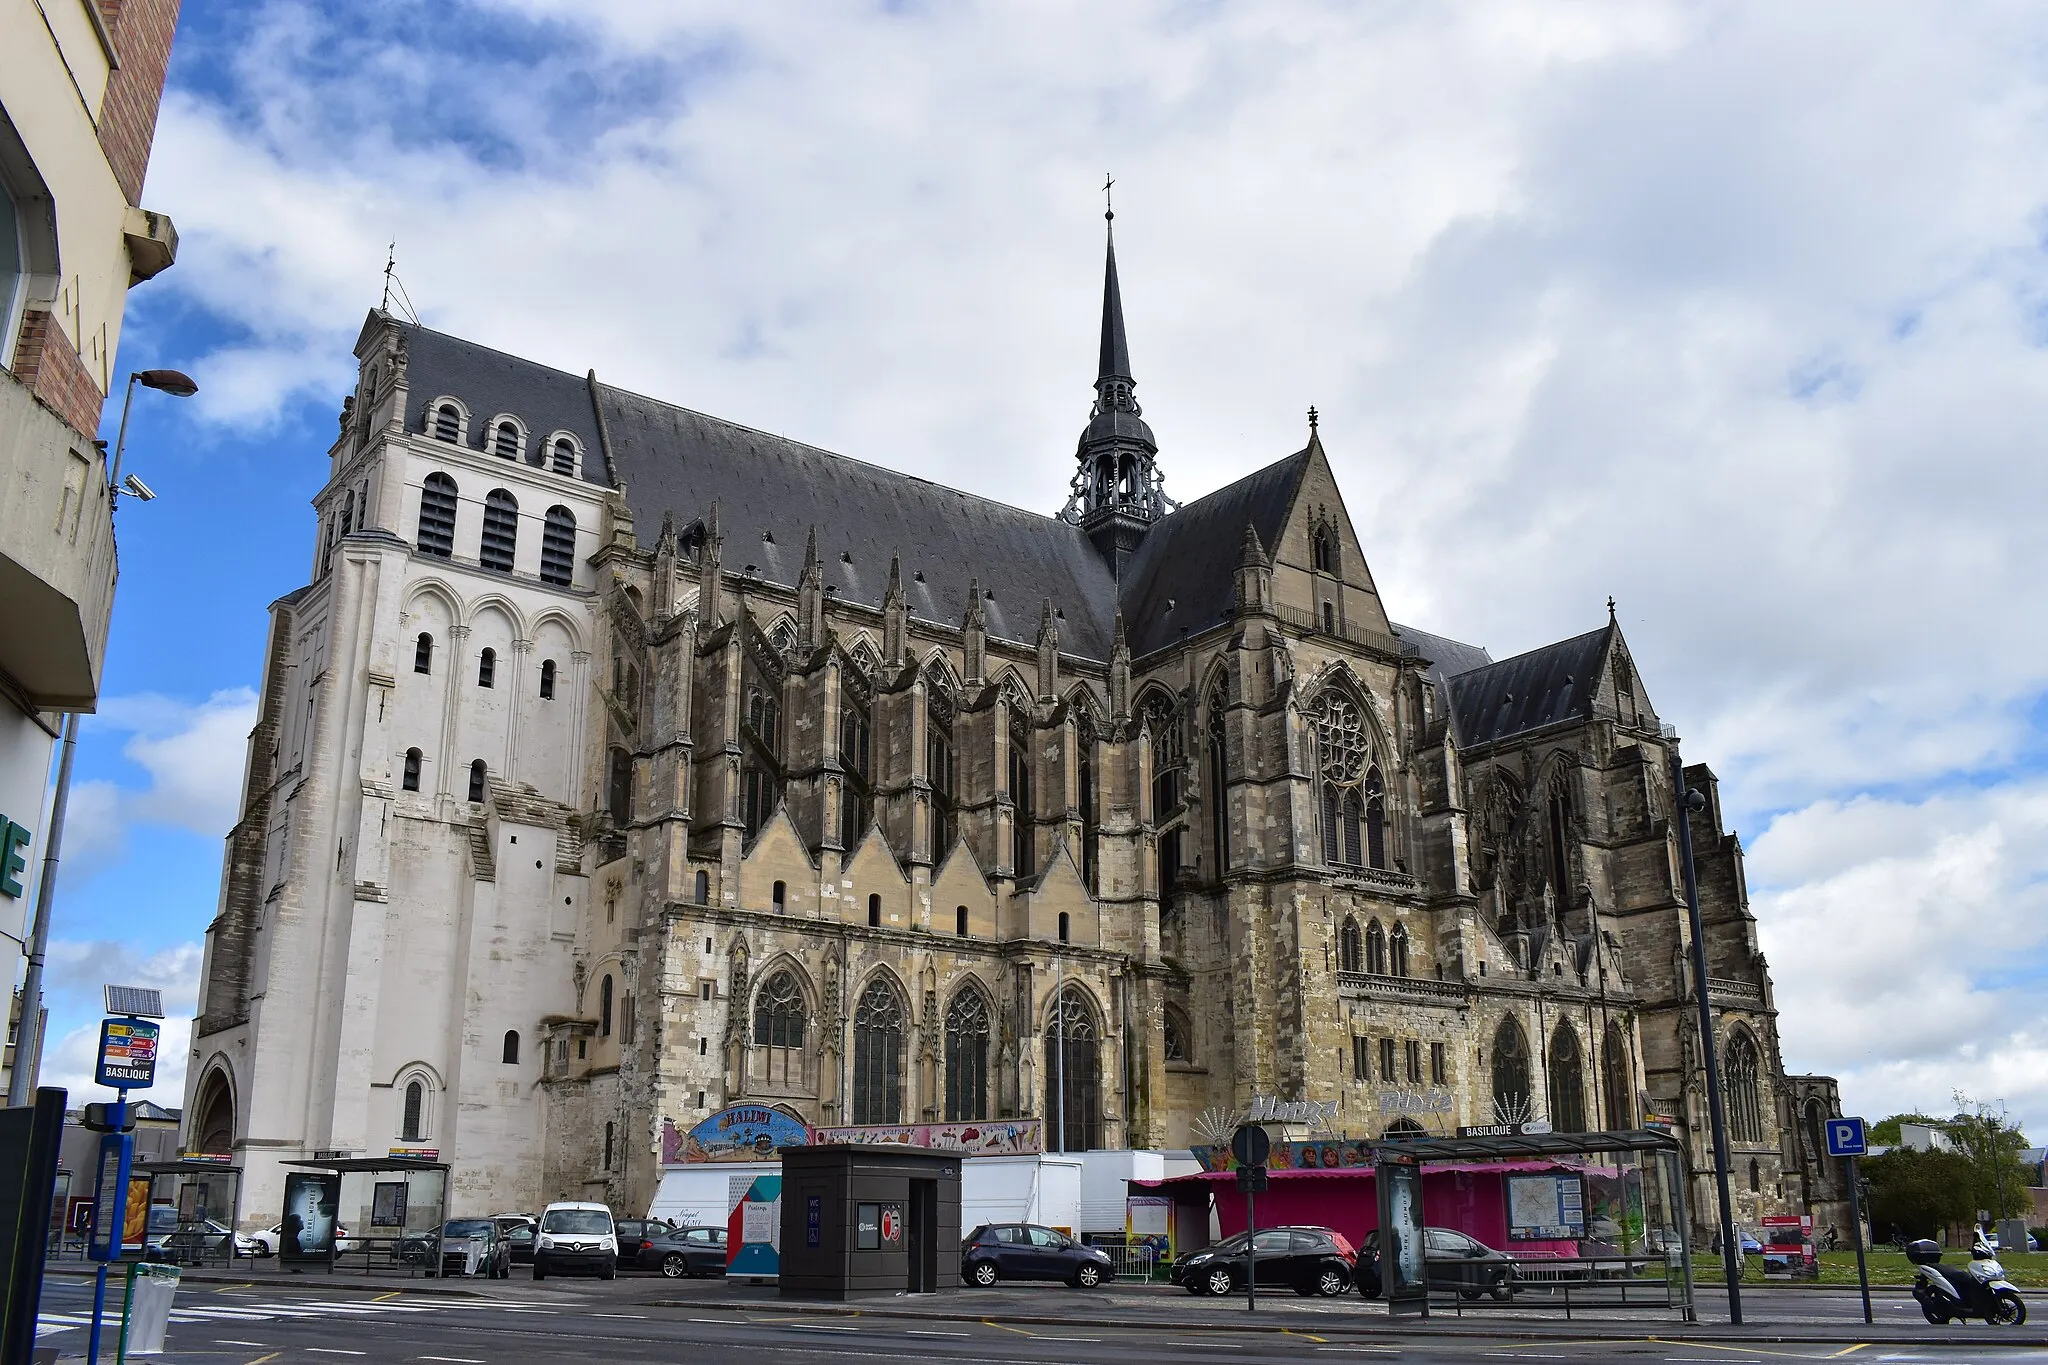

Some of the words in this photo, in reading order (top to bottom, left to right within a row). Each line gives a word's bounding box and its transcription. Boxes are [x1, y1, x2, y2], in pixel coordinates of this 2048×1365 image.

[105, 1067, 150, 1080] BASILIQUE
[726, 1109, 772, 1127] HALIMI
[1466, 1125, 1512, 1137] BASILIQUE
[1836, 1125, 1853, 1149] P
[308, 1189, 316, 1214] MONDES
[810, 1199, 819, 1207] WC
